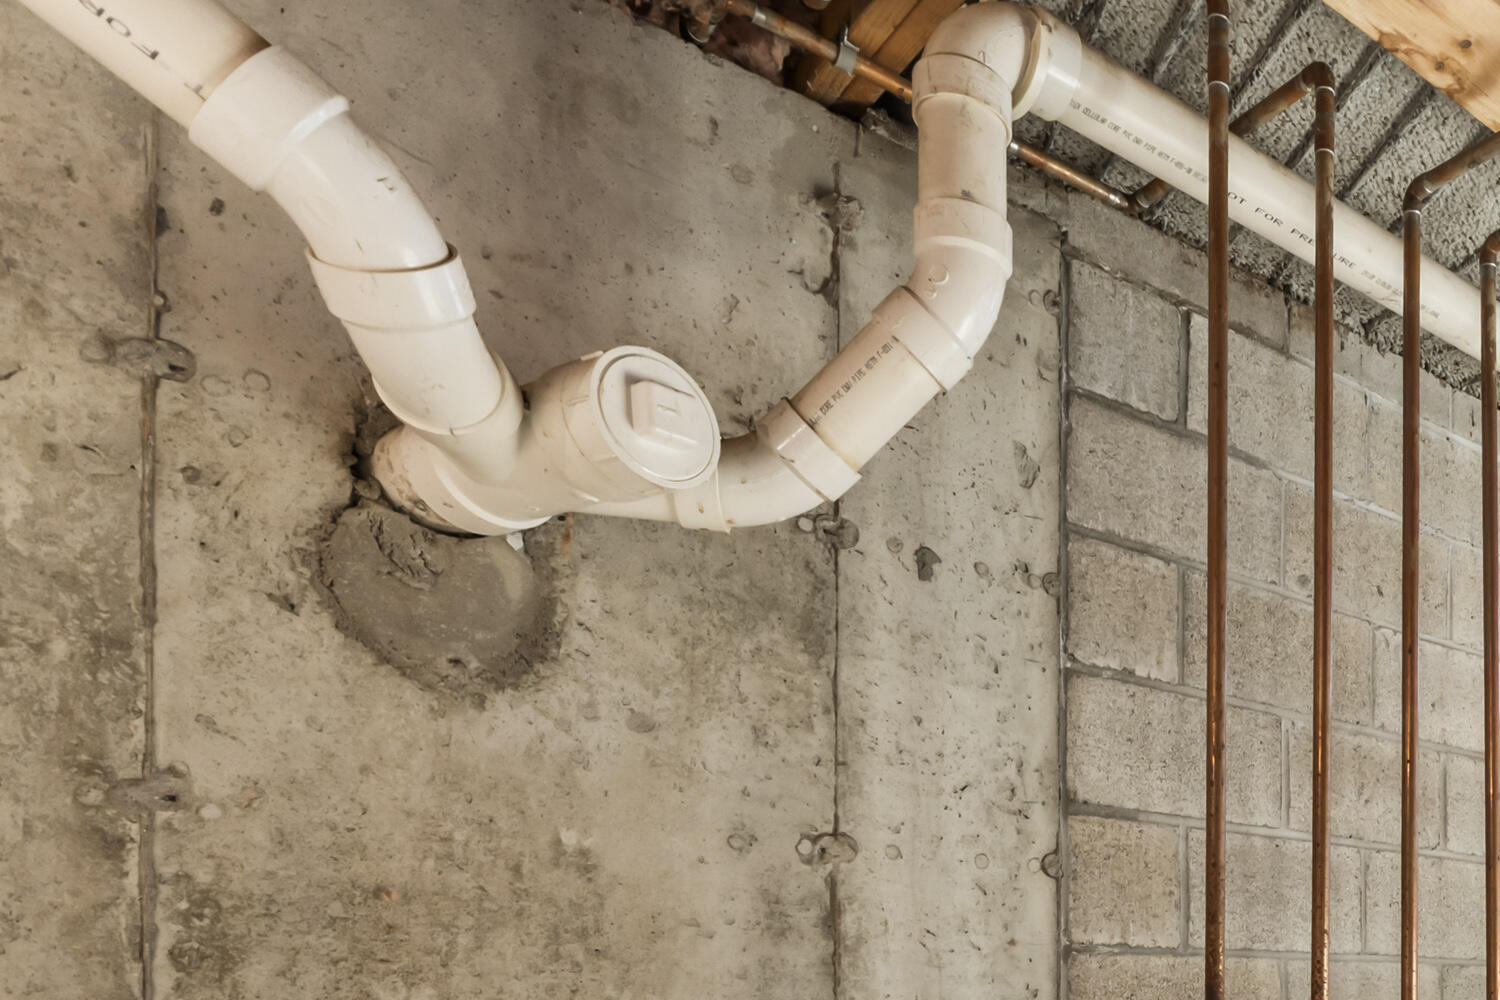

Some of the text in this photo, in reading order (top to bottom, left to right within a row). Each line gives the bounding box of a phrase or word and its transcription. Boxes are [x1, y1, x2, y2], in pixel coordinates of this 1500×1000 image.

[1228, 191, 1357, 269] OT FOR PREURE
